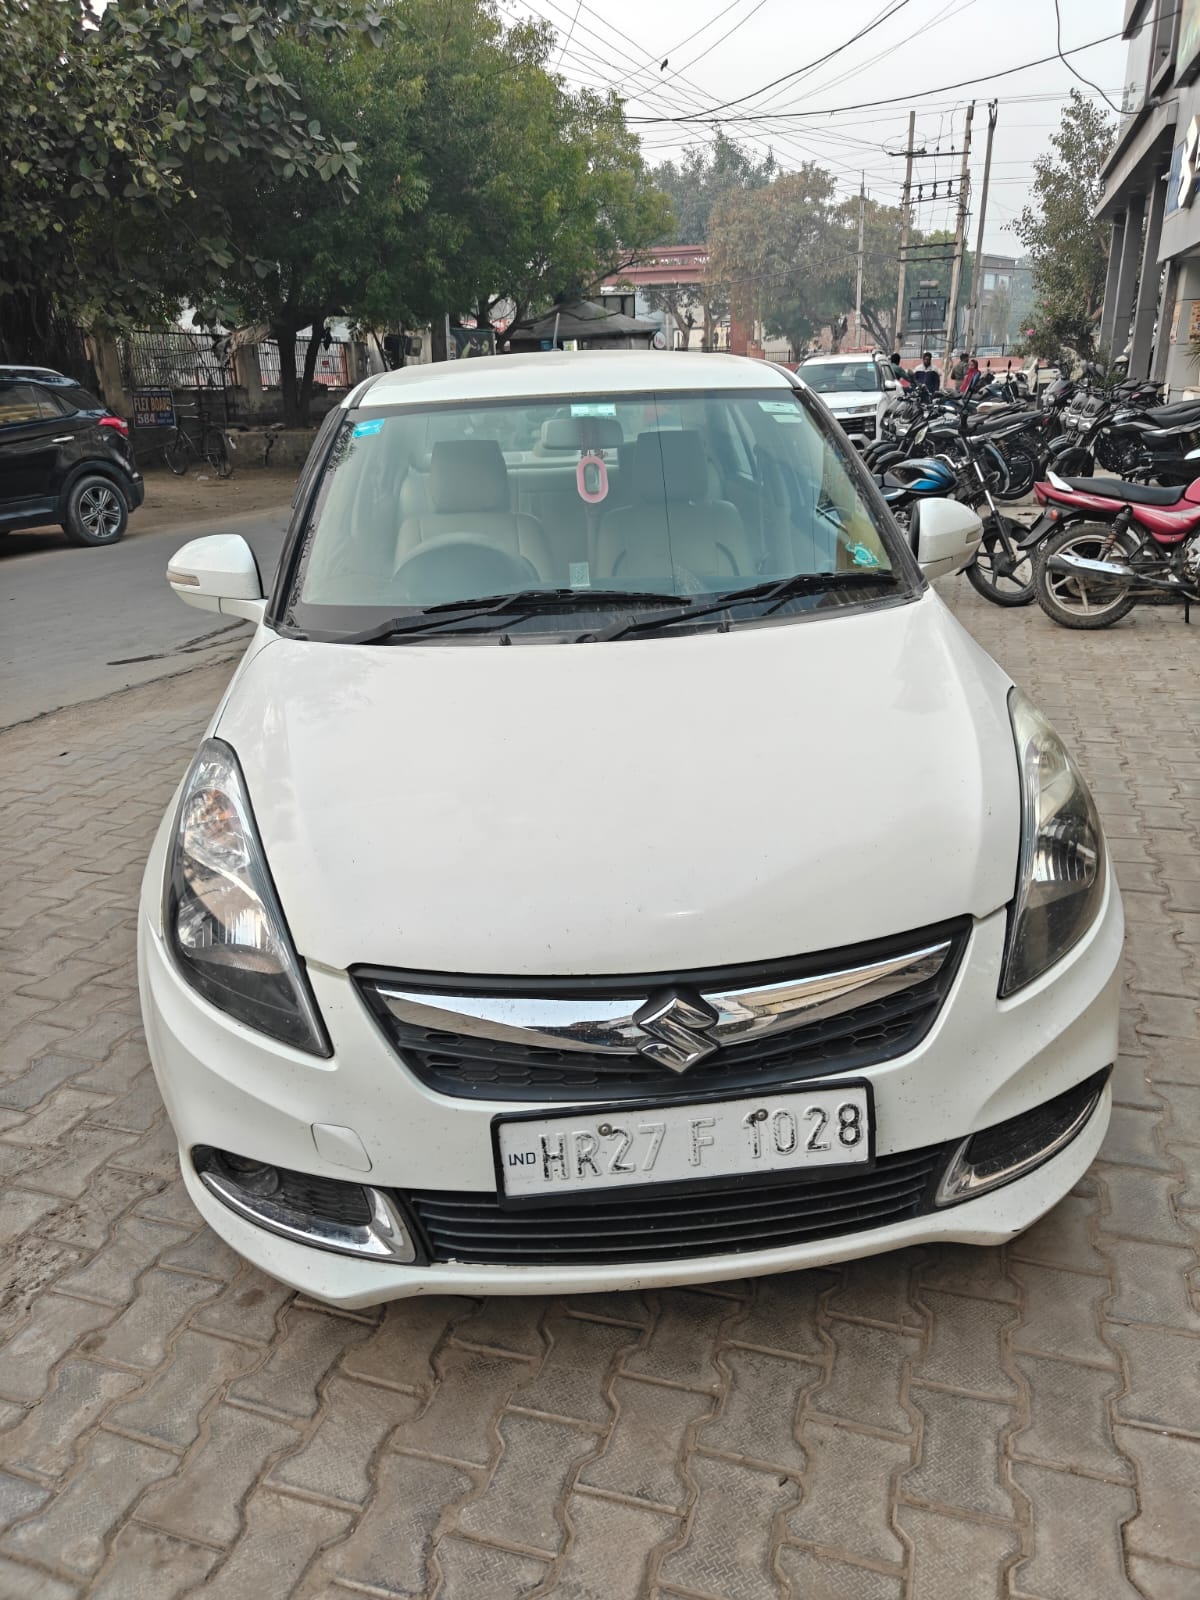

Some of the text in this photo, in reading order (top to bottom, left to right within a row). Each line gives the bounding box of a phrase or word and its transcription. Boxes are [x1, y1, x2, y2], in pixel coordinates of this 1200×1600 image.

[133, 396, 150, 411] FLEX
[538, 1102, 862, 1181] HR27 F 1028
[508, 1152, 536, 1166] IND
